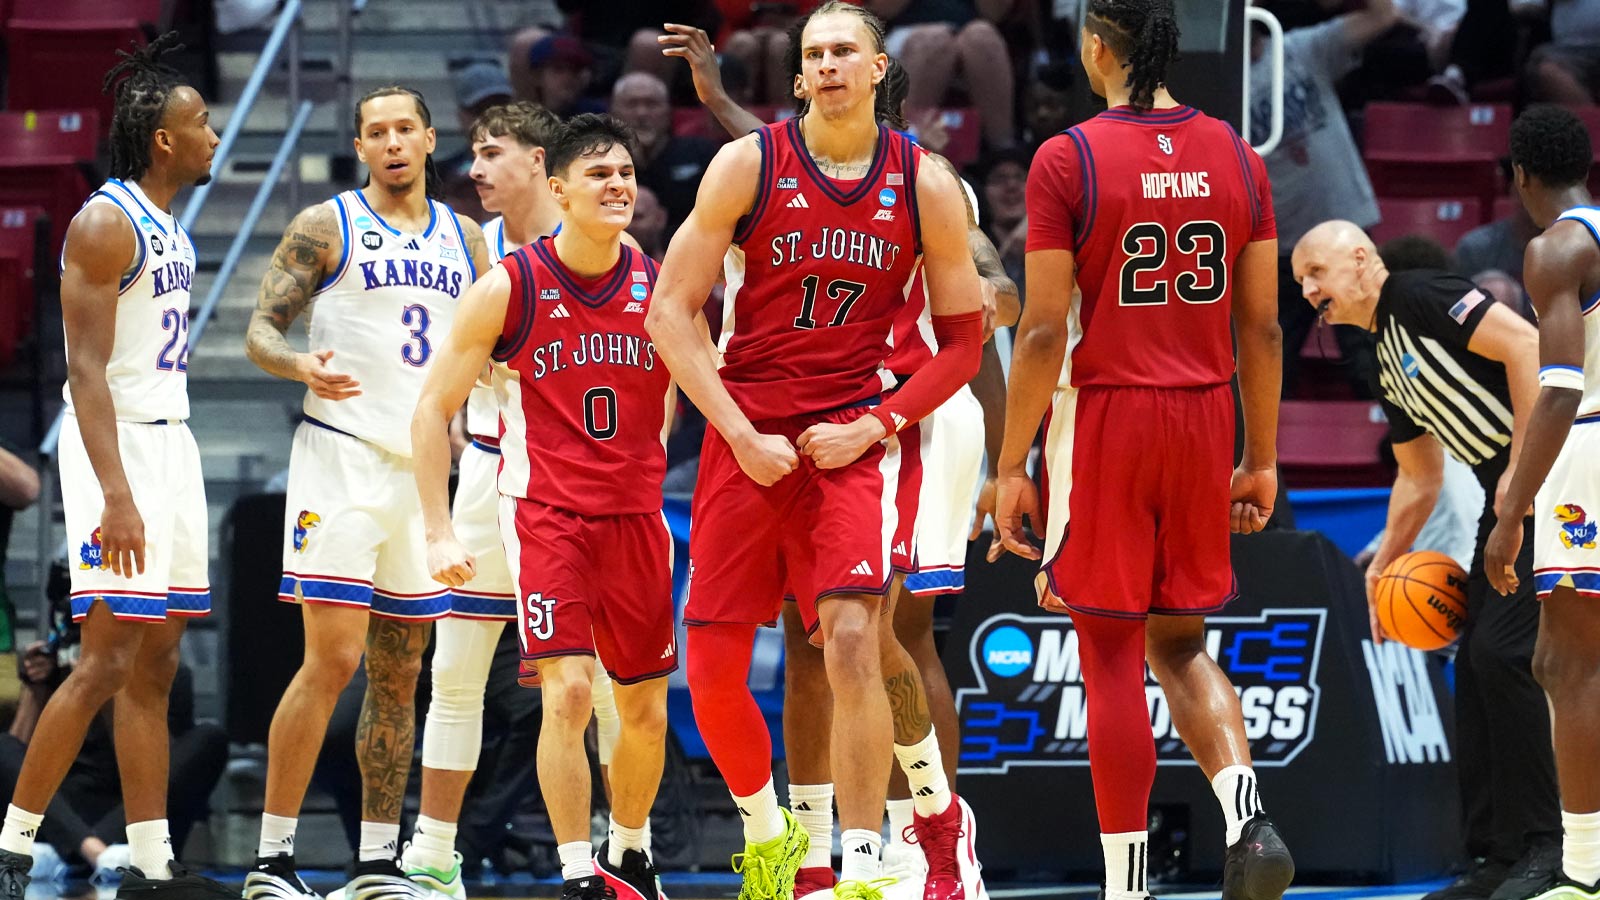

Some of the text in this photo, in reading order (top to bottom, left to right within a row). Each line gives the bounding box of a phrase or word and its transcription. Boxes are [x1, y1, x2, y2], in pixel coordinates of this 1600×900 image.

[1140, 171, 1211, 199] HOPKINS
[363, 234, 381, 247] SW
[770, 226, 900, 271] ST. JOHN'S
[1119, 220, 1227, 306] 23
[151, 261, 194, 299] KANSA
[359, 258, 462, 299] KANSAS
[794, 274, 867, 330] 17
[401, 303, 432, 367] 3
[532, 333, 656, 380] ST. JOHN'S
[583, 386, 618, 440] 0
[1573, 527, 1588, 538] KU
[526, 592, 557, 641] SJ
[988, 650, 1031, 665] NCAA
